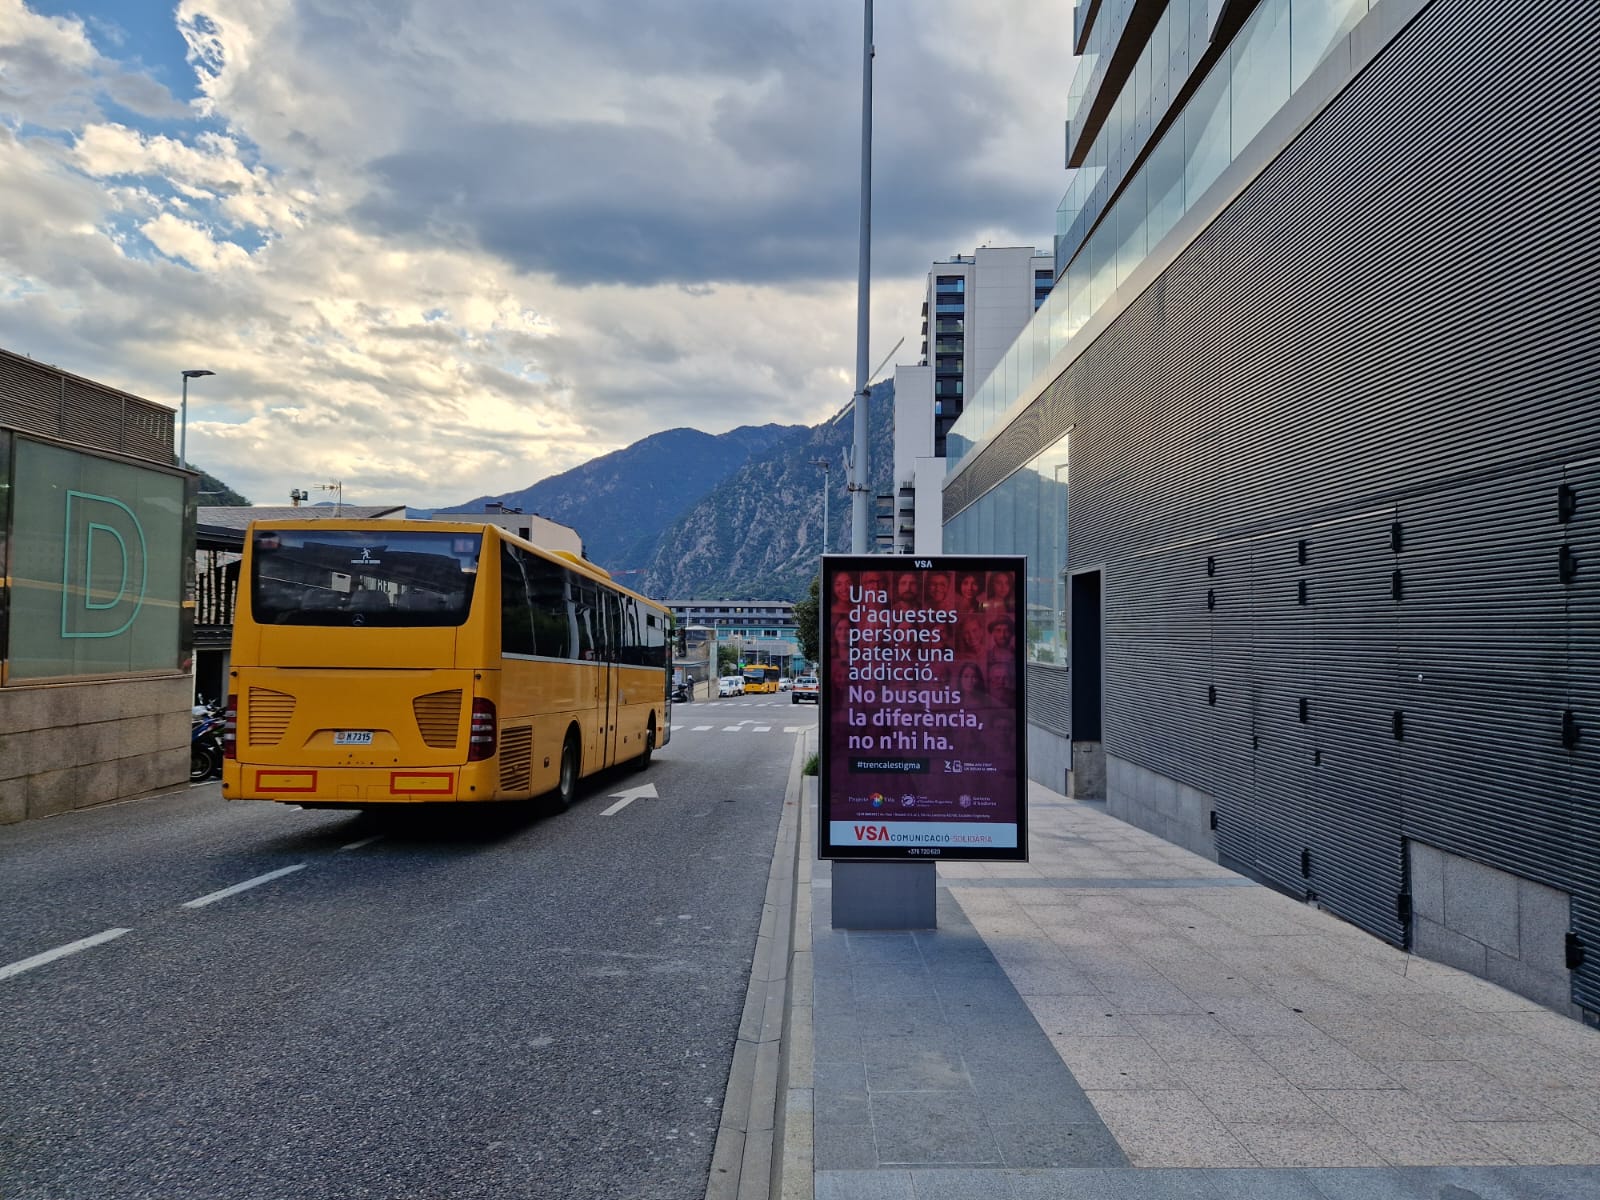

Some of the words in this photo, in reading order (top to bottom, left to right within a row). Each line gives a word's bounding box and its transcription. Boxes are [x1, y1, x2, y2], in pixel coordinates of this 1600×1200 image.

[914, 560, 933, 568] VSA
[849, 585, 888, 603] Una
[849, 605, 957, 628] d'aquestes
[849, 626, 941, 646] persones
[849, 645, 911, 665] pateix
[918, 649, 954, 662] una
[849, 663, 938, 681] addicció.
[849, 686, 876, 703] No
[882, 687, 961, 709] busquis
[849, 709, 868, 727] la
[873, 709, 984, 729] diferència,
[849, 734, 873, 750] no
[880, 731, 917, 750] n'hi
[923, 732, 954, 750] ha.
[857, 760, 921, 771] #trencalestigma
[854, 825, 890, 841] VSA
[890, 834, 950, 843] COMUNICACIÓ
